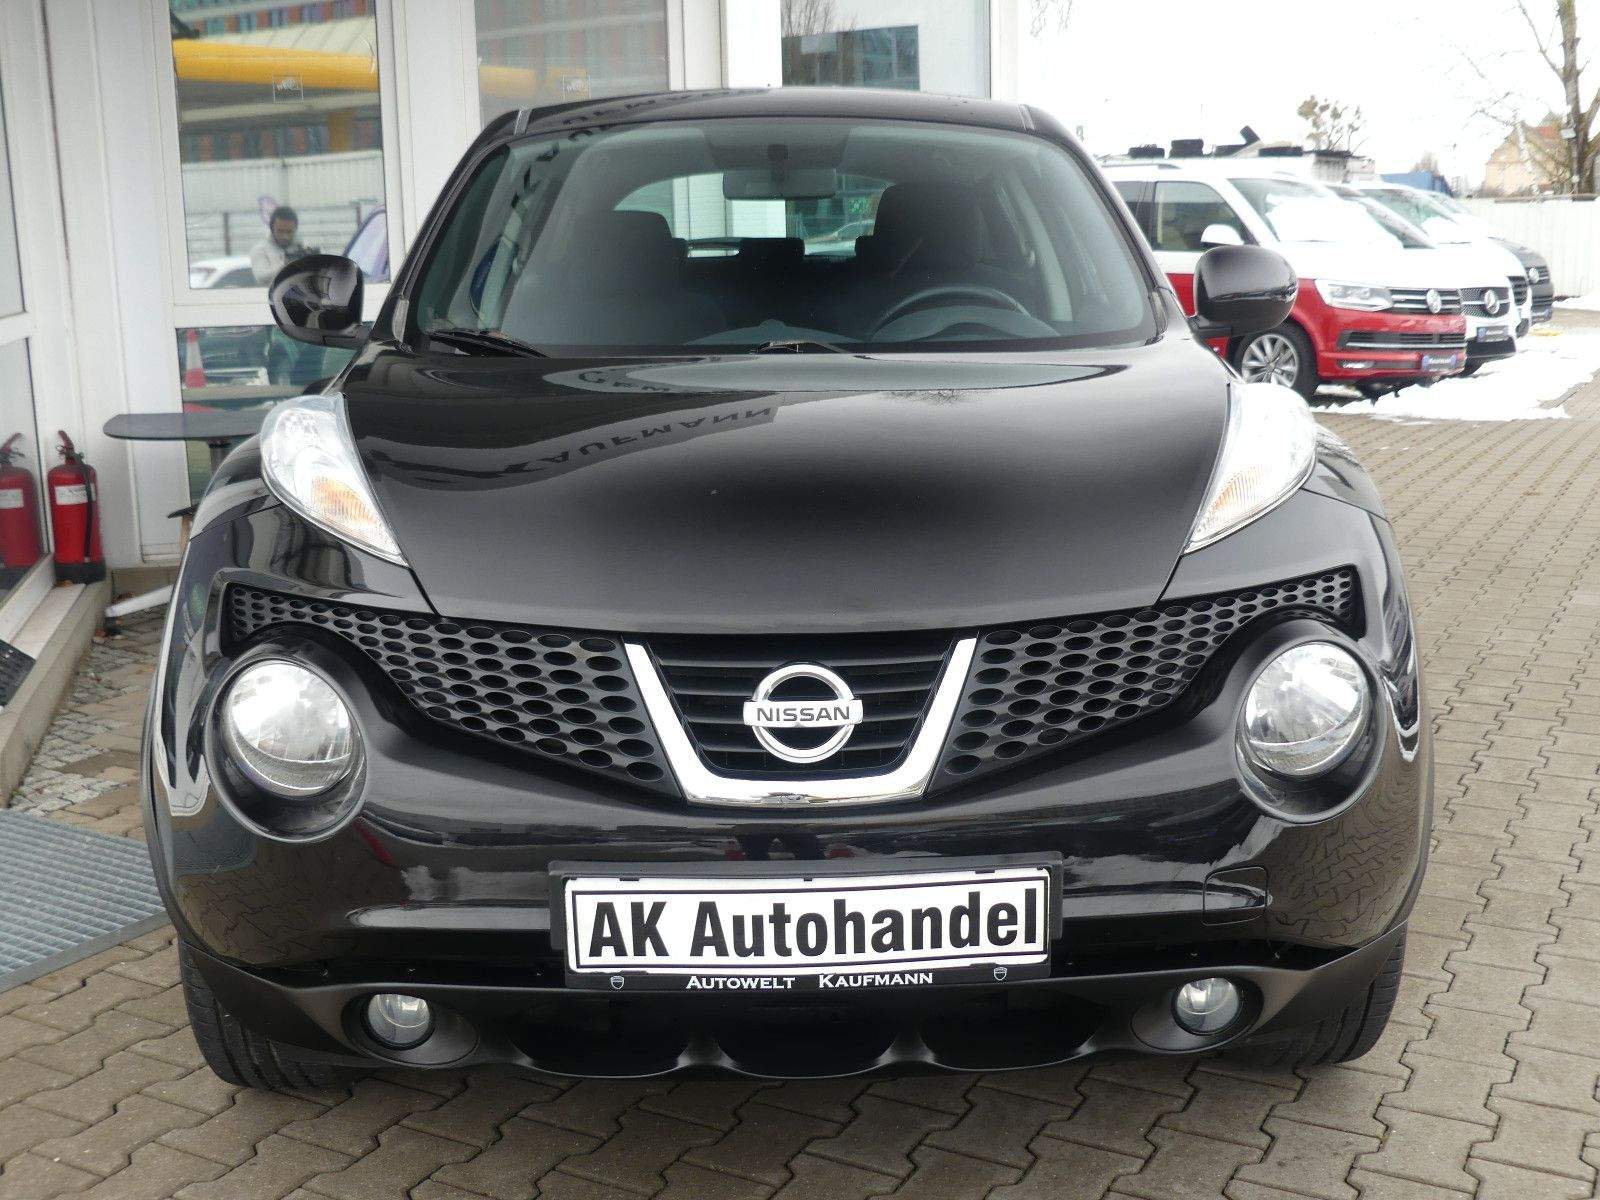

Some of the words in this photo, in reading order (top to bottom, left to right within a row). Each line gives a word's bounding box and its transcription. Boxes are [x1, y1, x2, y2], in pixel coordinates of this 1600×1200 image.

[756, 706, 850, 722] NISSAN
[588, 901, 670, 958] AK
[689, 888, 1037, 957] Autohandel
[685, 975, 796, 990] AUTOWELT
[818, 972, 934, 989] KAUFMANN
